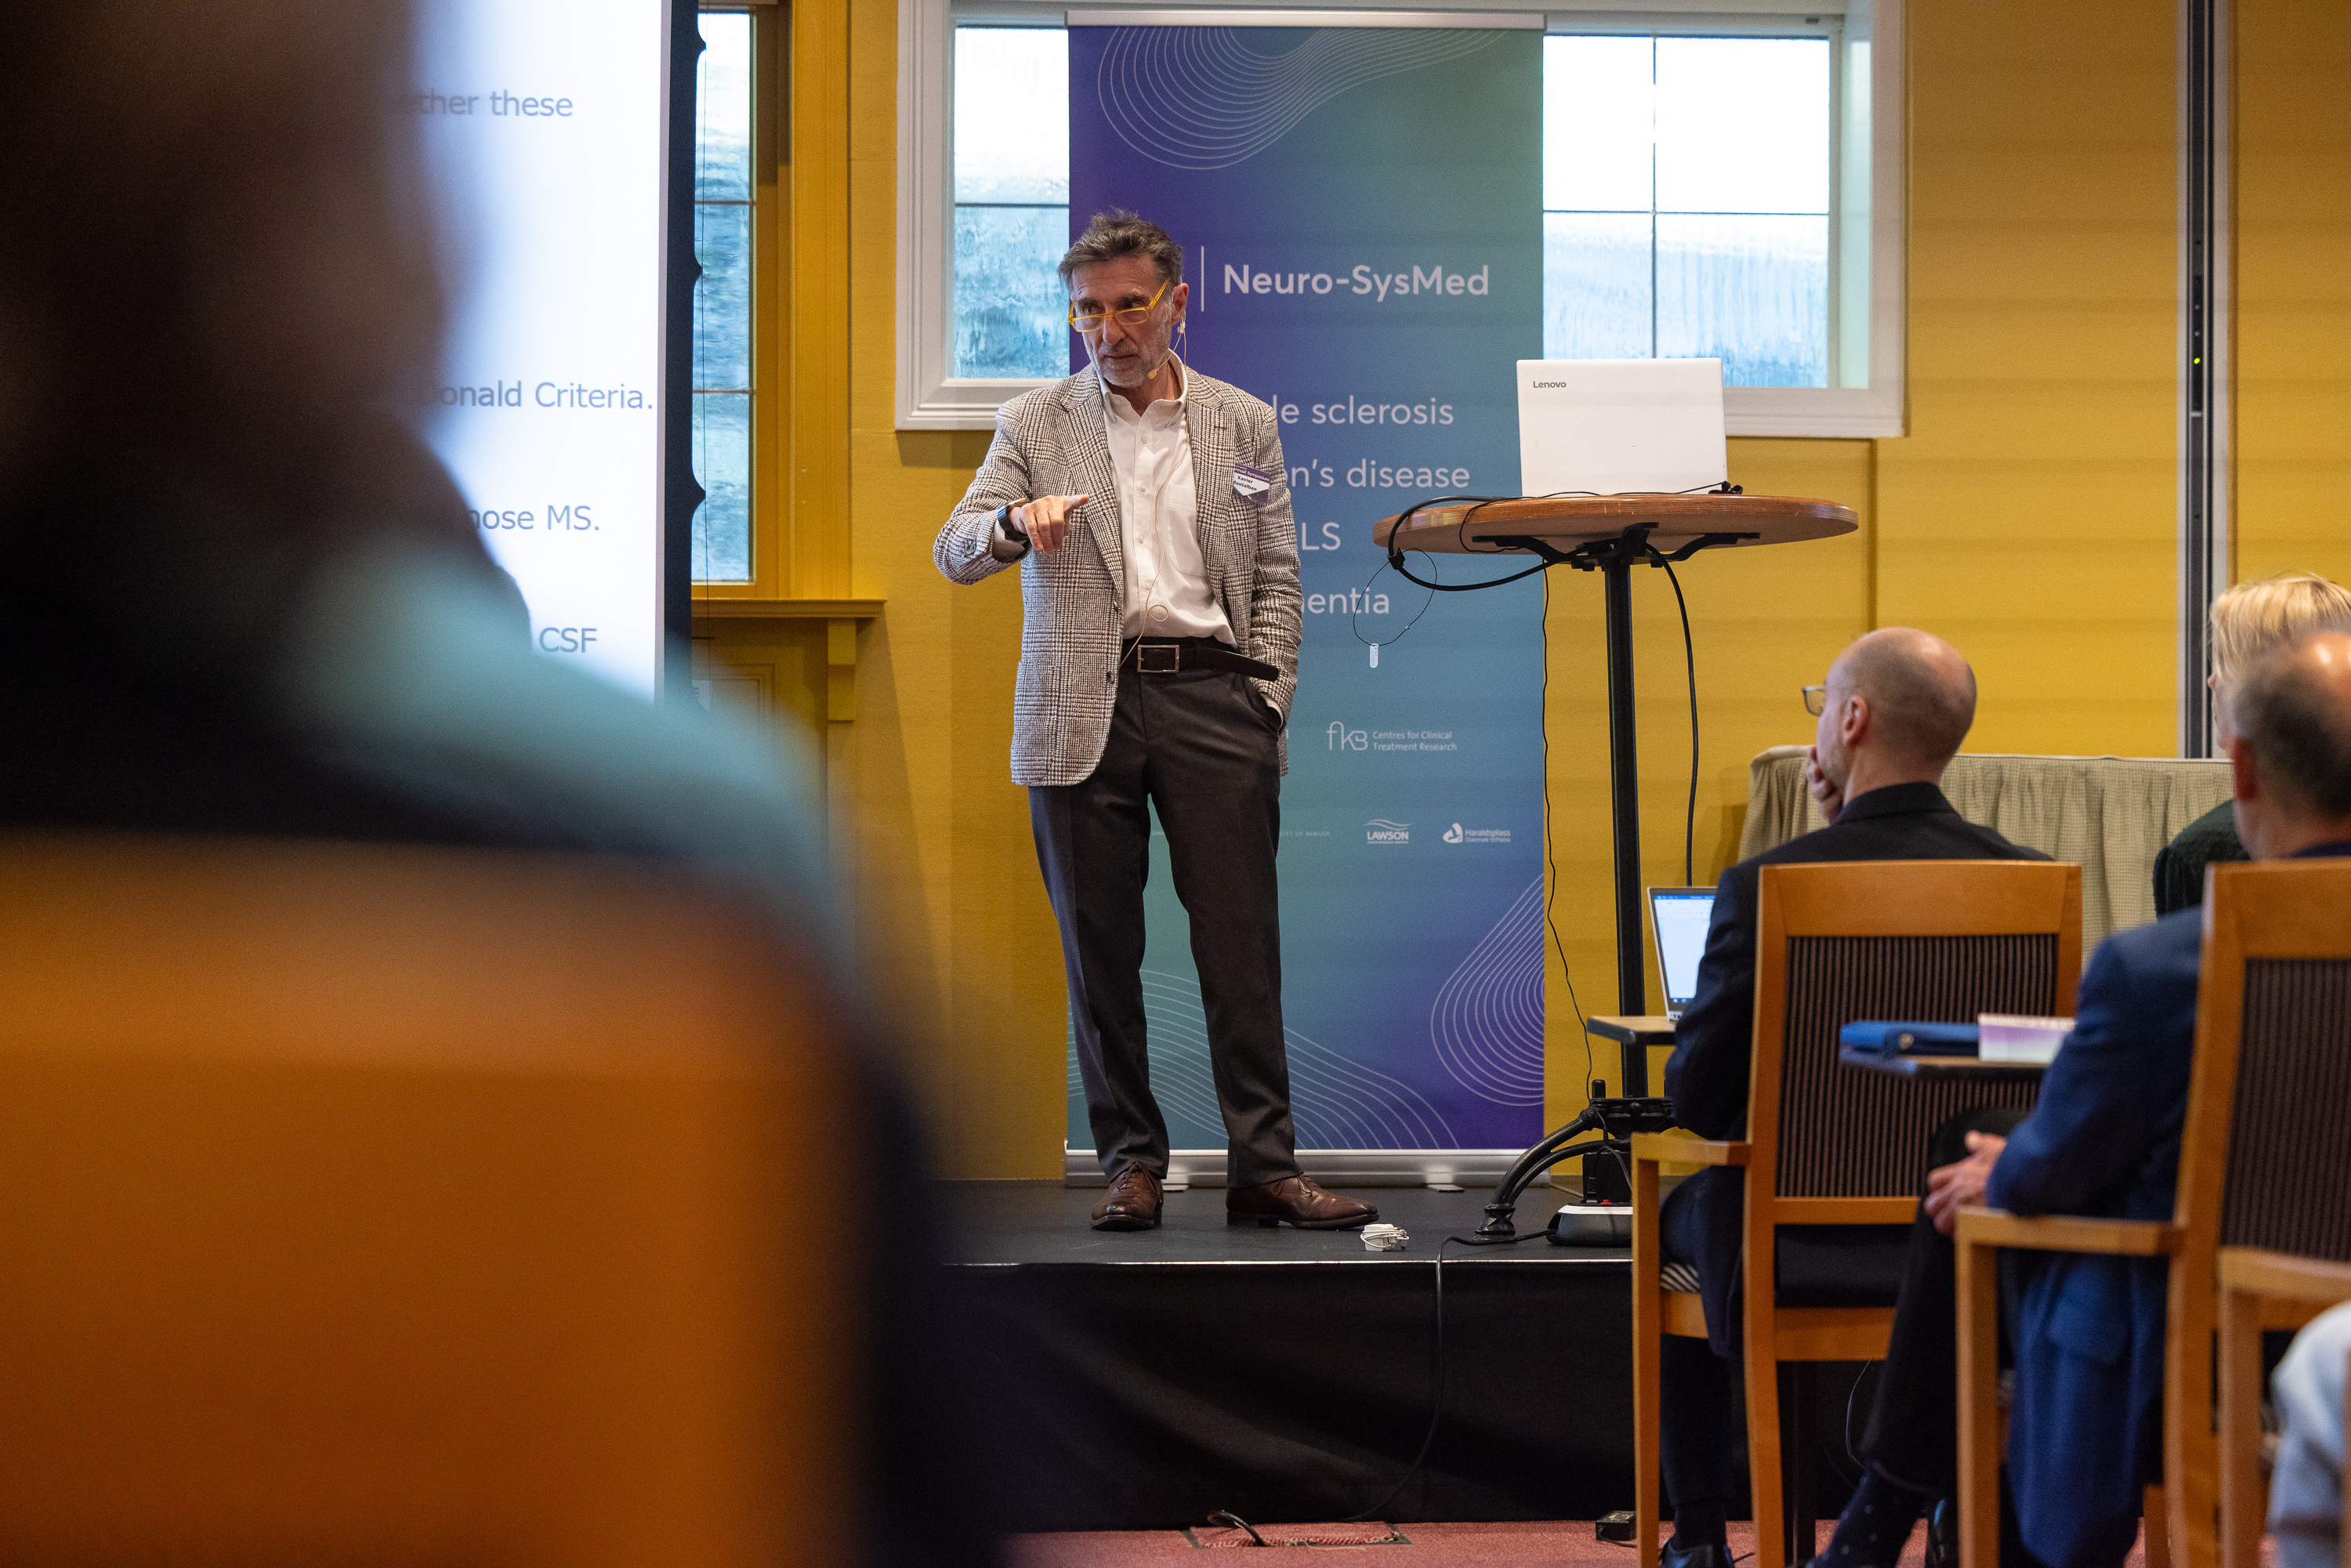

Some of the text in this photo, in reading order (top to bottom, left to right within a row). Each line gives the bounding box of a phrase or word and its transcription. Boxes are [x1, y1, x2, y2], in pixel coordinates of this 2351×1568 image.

[418, 89, 573, 117] ther these
[1224, 265, 1489, 302] Neuro-SysMed
[439, 381, 653, 409] onald Criteria.
[1273, 395, 1454, 425] le sclerosis
[1284, 458, 1470, 488] n's disease
[470, 505, 600, 531] nose MS.
[1302, 522, 1341, 550] LS
[1301, 587, 1389, 614] entia
[538, 627, 597, 653] CSF
[1372, 730, 1452, 740] Centres for Clinical
[1373, 743, 1458, 751] Treatment Research
[1367, 831, 1409, 840] LAWSON
